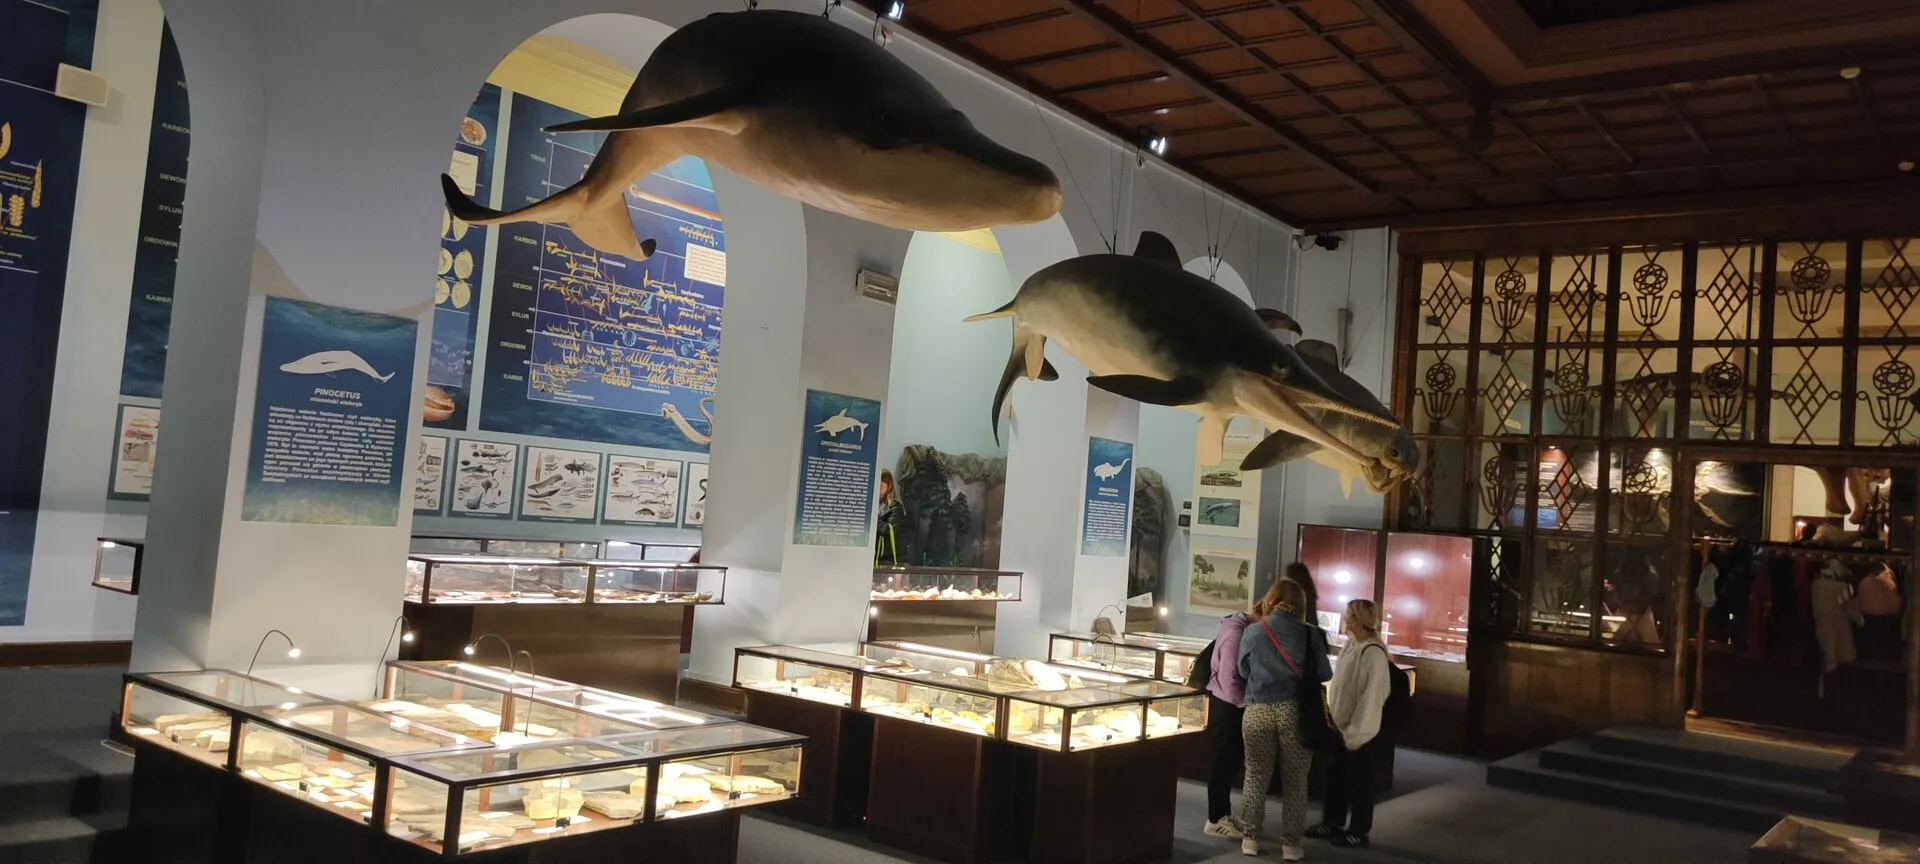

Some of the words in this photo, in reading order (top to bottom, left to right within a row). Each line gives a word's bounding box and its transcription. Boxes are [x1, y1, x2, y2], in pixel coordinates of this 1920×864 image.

[159, 205, 183, 214] SYLUR
[144, 236, 178, 248] ORDOWIK
[514, 235, 538, 246] KARBON
[512, 282, 533, 291] DEWON
[511, 311, 530, 319] SYLUR
[314, 387, 361, 399] PINOCETUS
